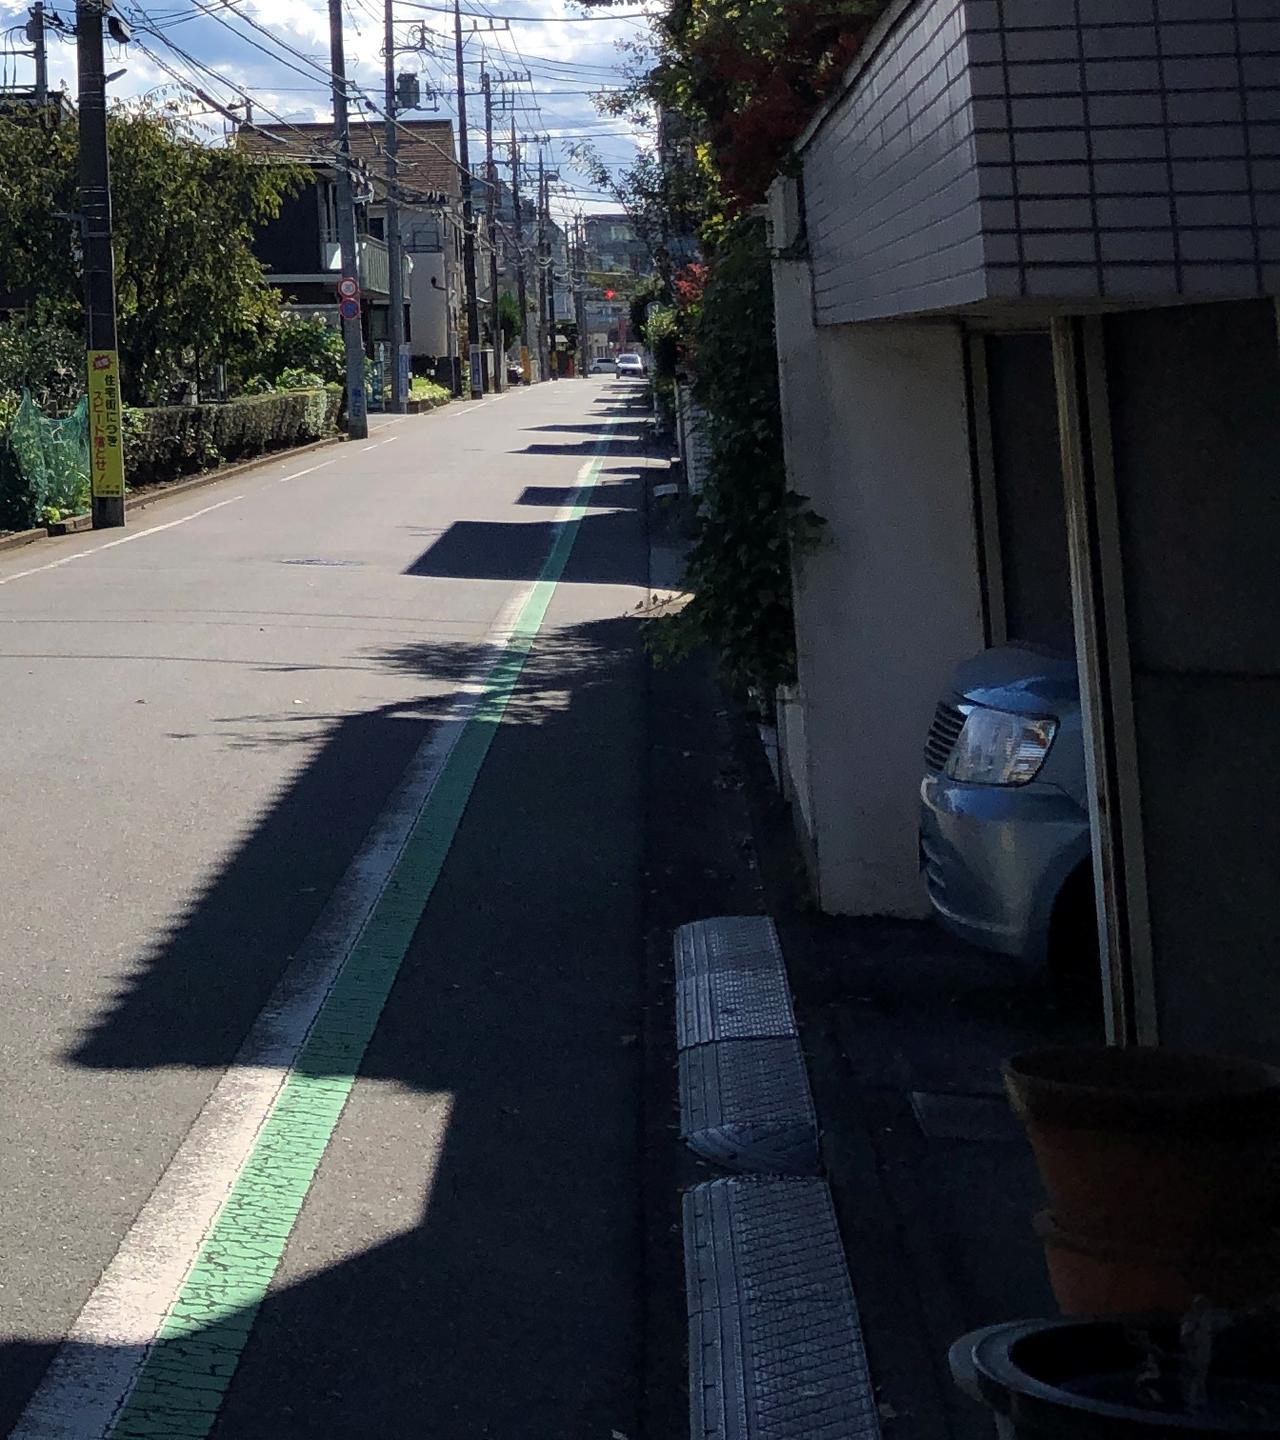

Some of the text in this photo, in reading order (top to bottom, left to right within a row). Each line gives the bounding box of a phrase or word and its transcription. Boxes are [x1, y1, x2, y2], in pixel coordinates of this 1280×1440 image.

[104, 374, 118, 448] 住宅街につき
